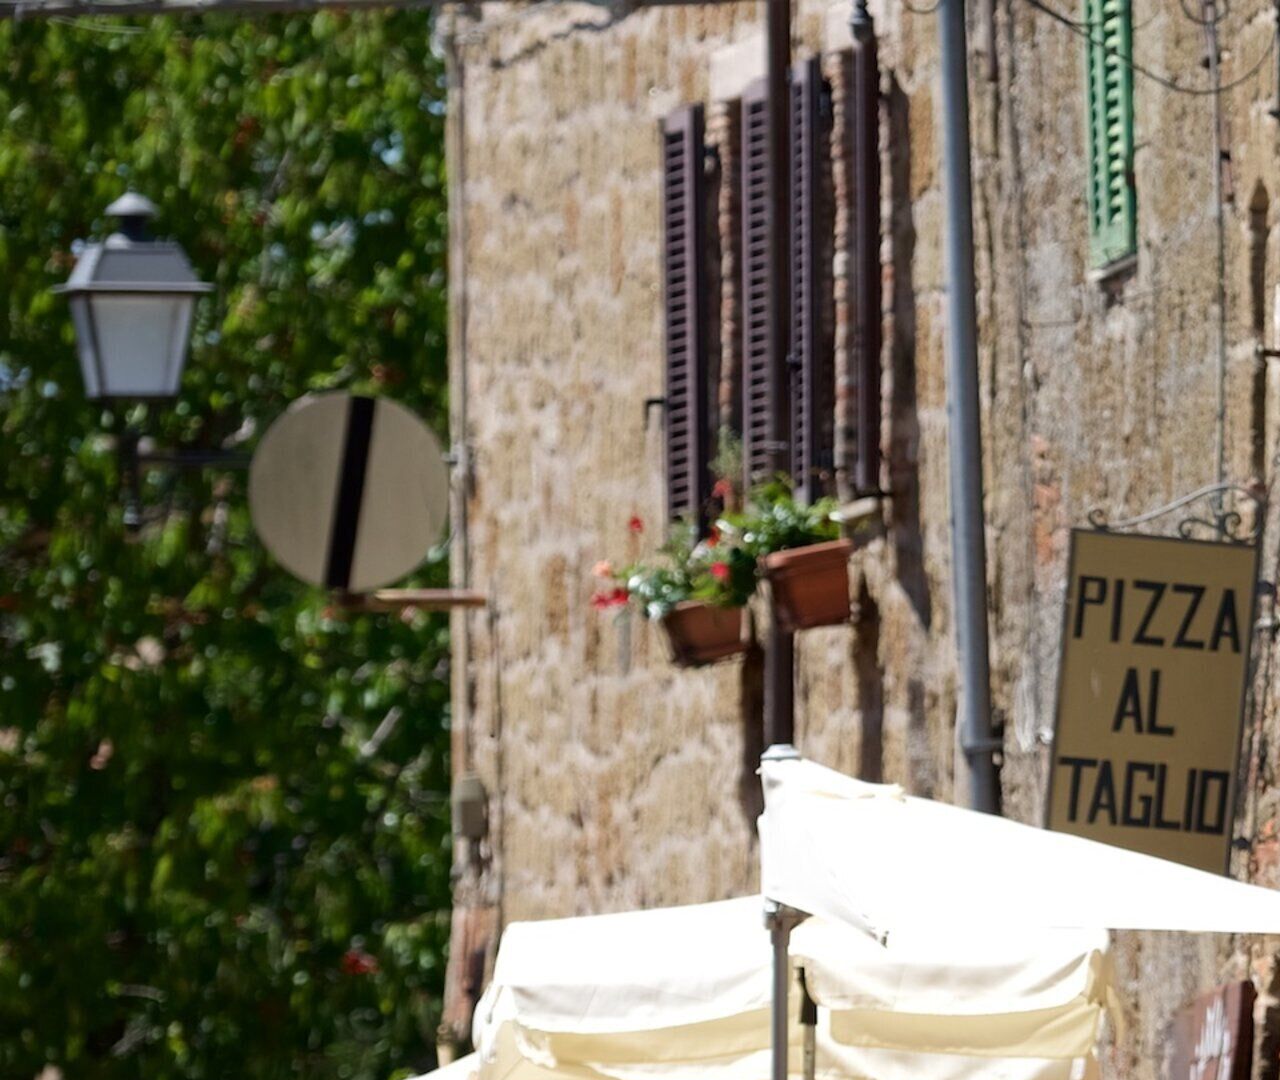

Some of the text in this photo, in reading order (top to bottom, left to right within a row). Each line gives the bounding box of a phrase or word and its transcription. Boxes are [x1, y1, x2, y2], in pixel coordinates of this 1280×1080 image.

[1073, 575, 1241, 654] PIZZA
[1111, 668, 1176, 736] AL
[1057, 756, 1230, 835] TAGLIO
